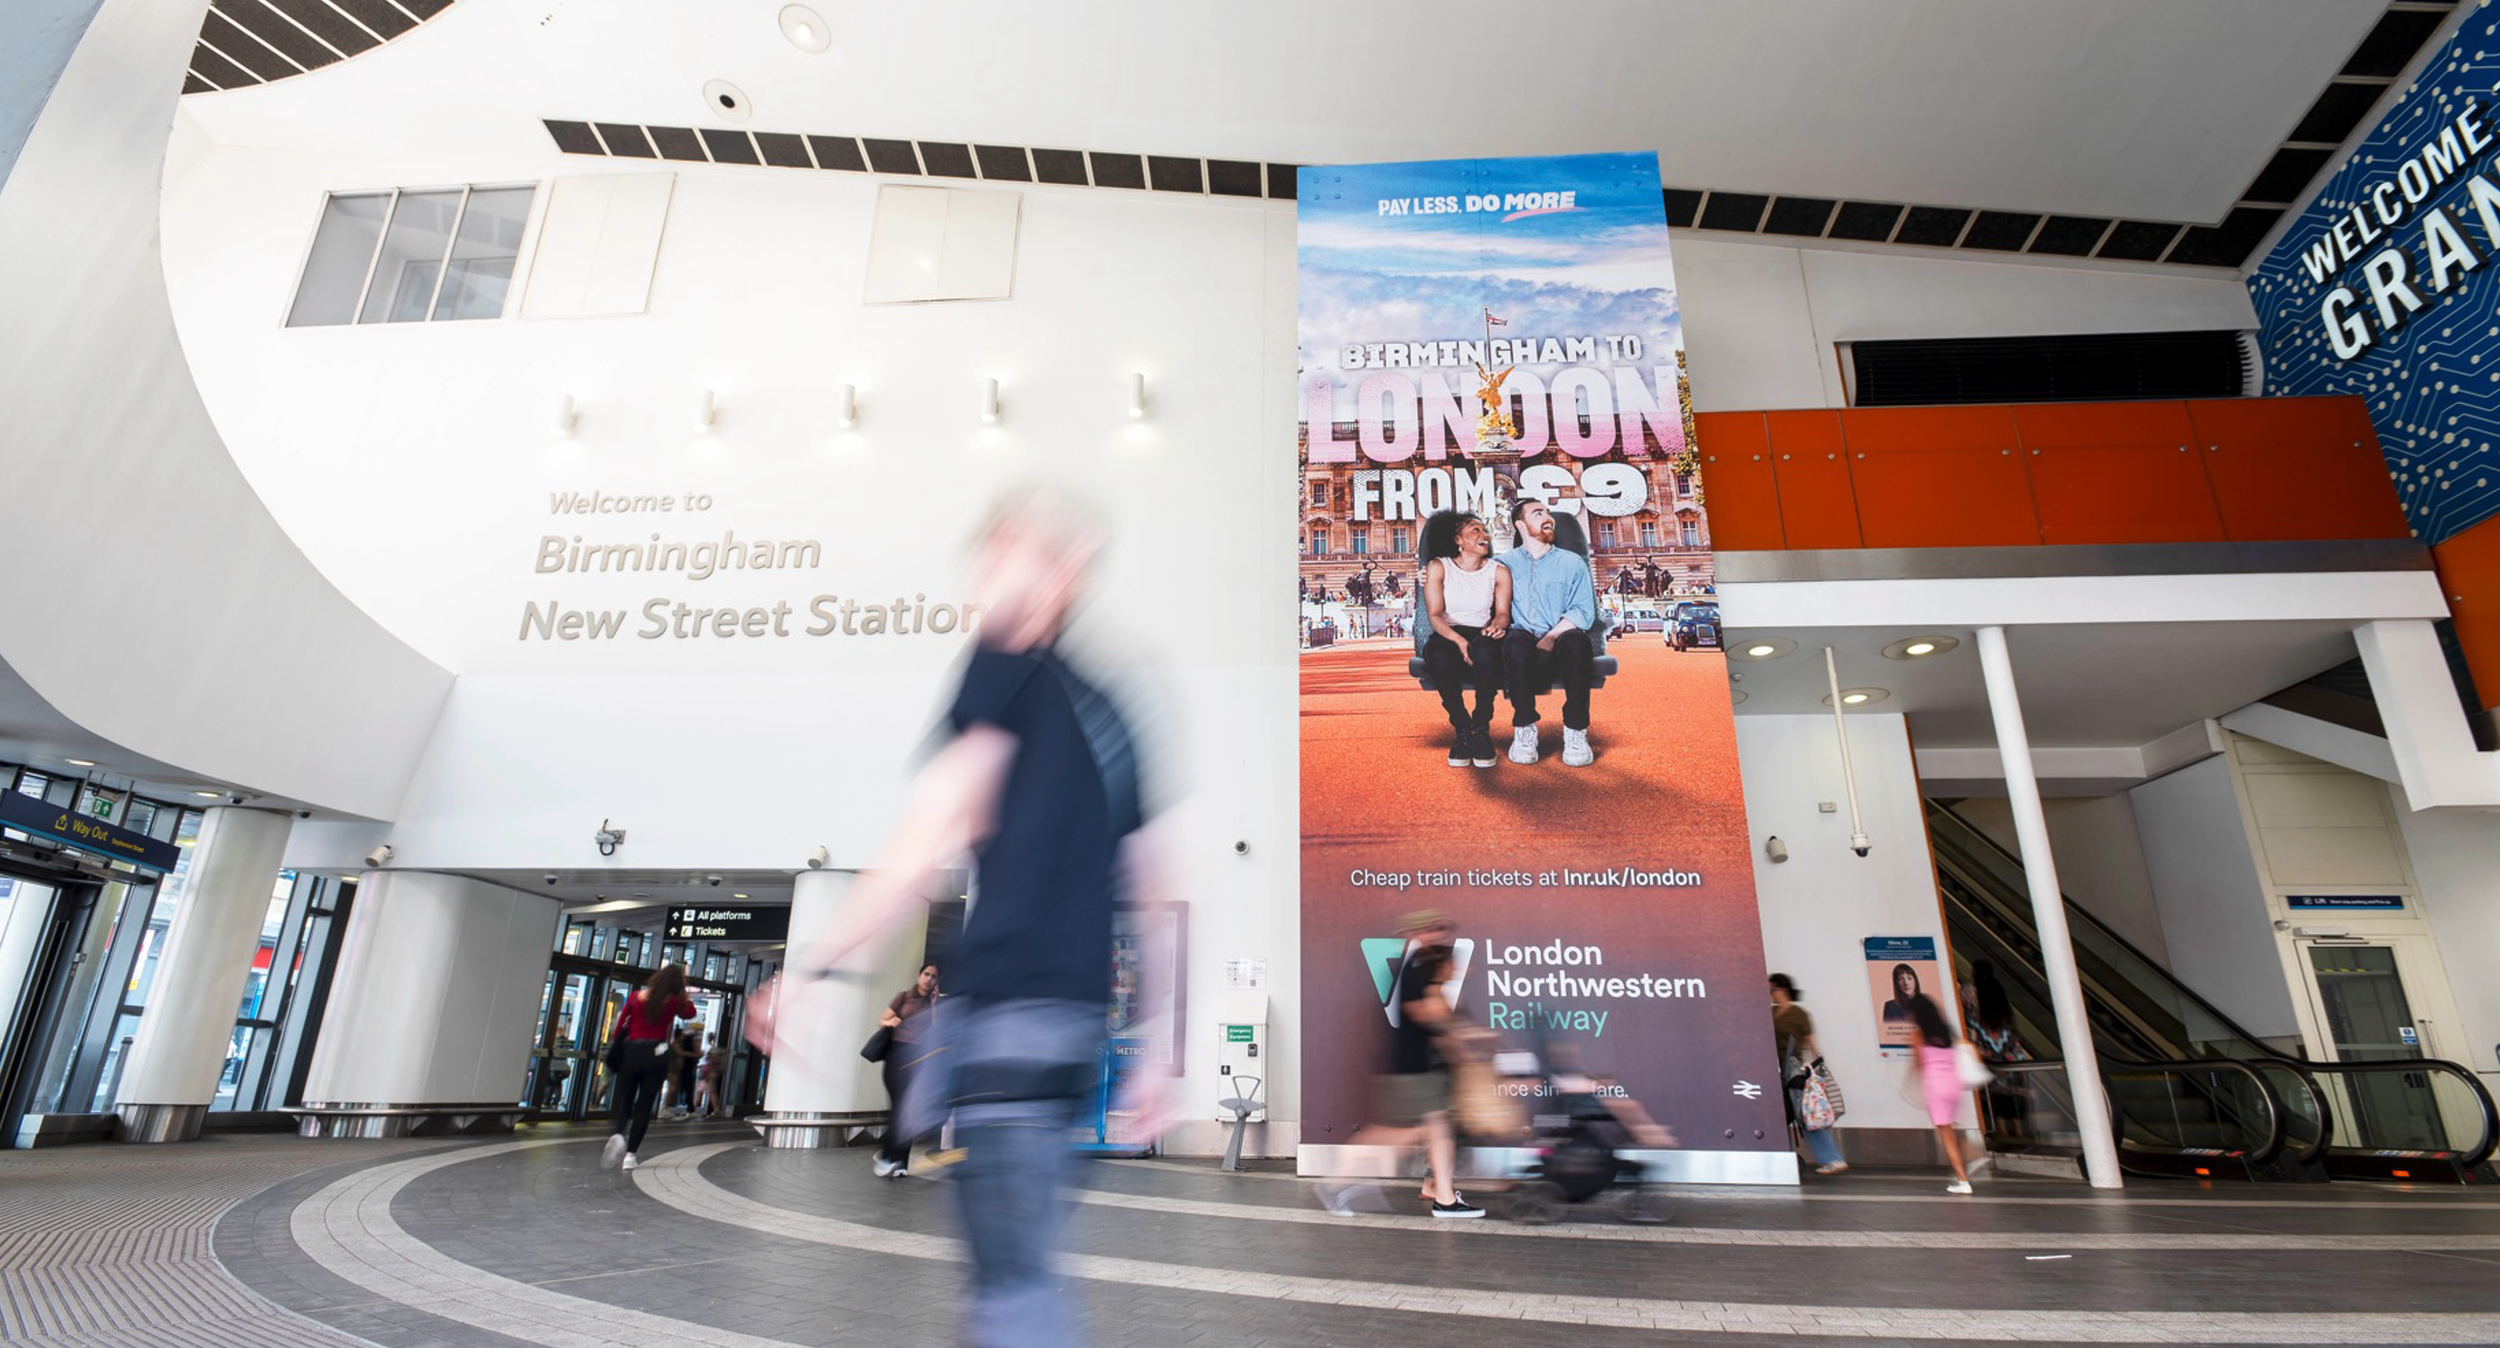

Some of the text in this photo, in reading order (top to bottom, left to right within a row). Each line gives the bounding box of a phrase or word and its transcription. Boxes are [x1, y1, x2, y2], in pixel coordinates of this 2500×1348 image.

[1378, 198, 1411, 216] PAY
[1466, 194, 1500, 212] DO
[1503, 191, 1576, 211] MORE
[2301, 103, 2494, 285] WELCOME
[1341, 334, 1643, 369] BIRMINGHAM TO
[1306, 365, 1686, 463] LONDON
[549, 489, 713, 514] Welcome to
[1353, 467, 1496, 521] FROM
[534, 530, 822, 580] Birmingham
[519, 600, 626, 641] New
[637, 596, 793, 640] Street
[73, 819, 91, 838] Way
[92, 826, 108, 841] Out
[1351, 867, 1701, 890] Cheap train tickets at lnr.uk/london
[697, 911, 752, 921] All platforms
[696, 926, 726, 936] Tickets
[1486, 938, 1602, 965] London
[1487, 970, 1705, 998] Northwestern
[1490, 1002, 1609, 1036] Railway
[1116, 1047, 1146, 1056] METRO
